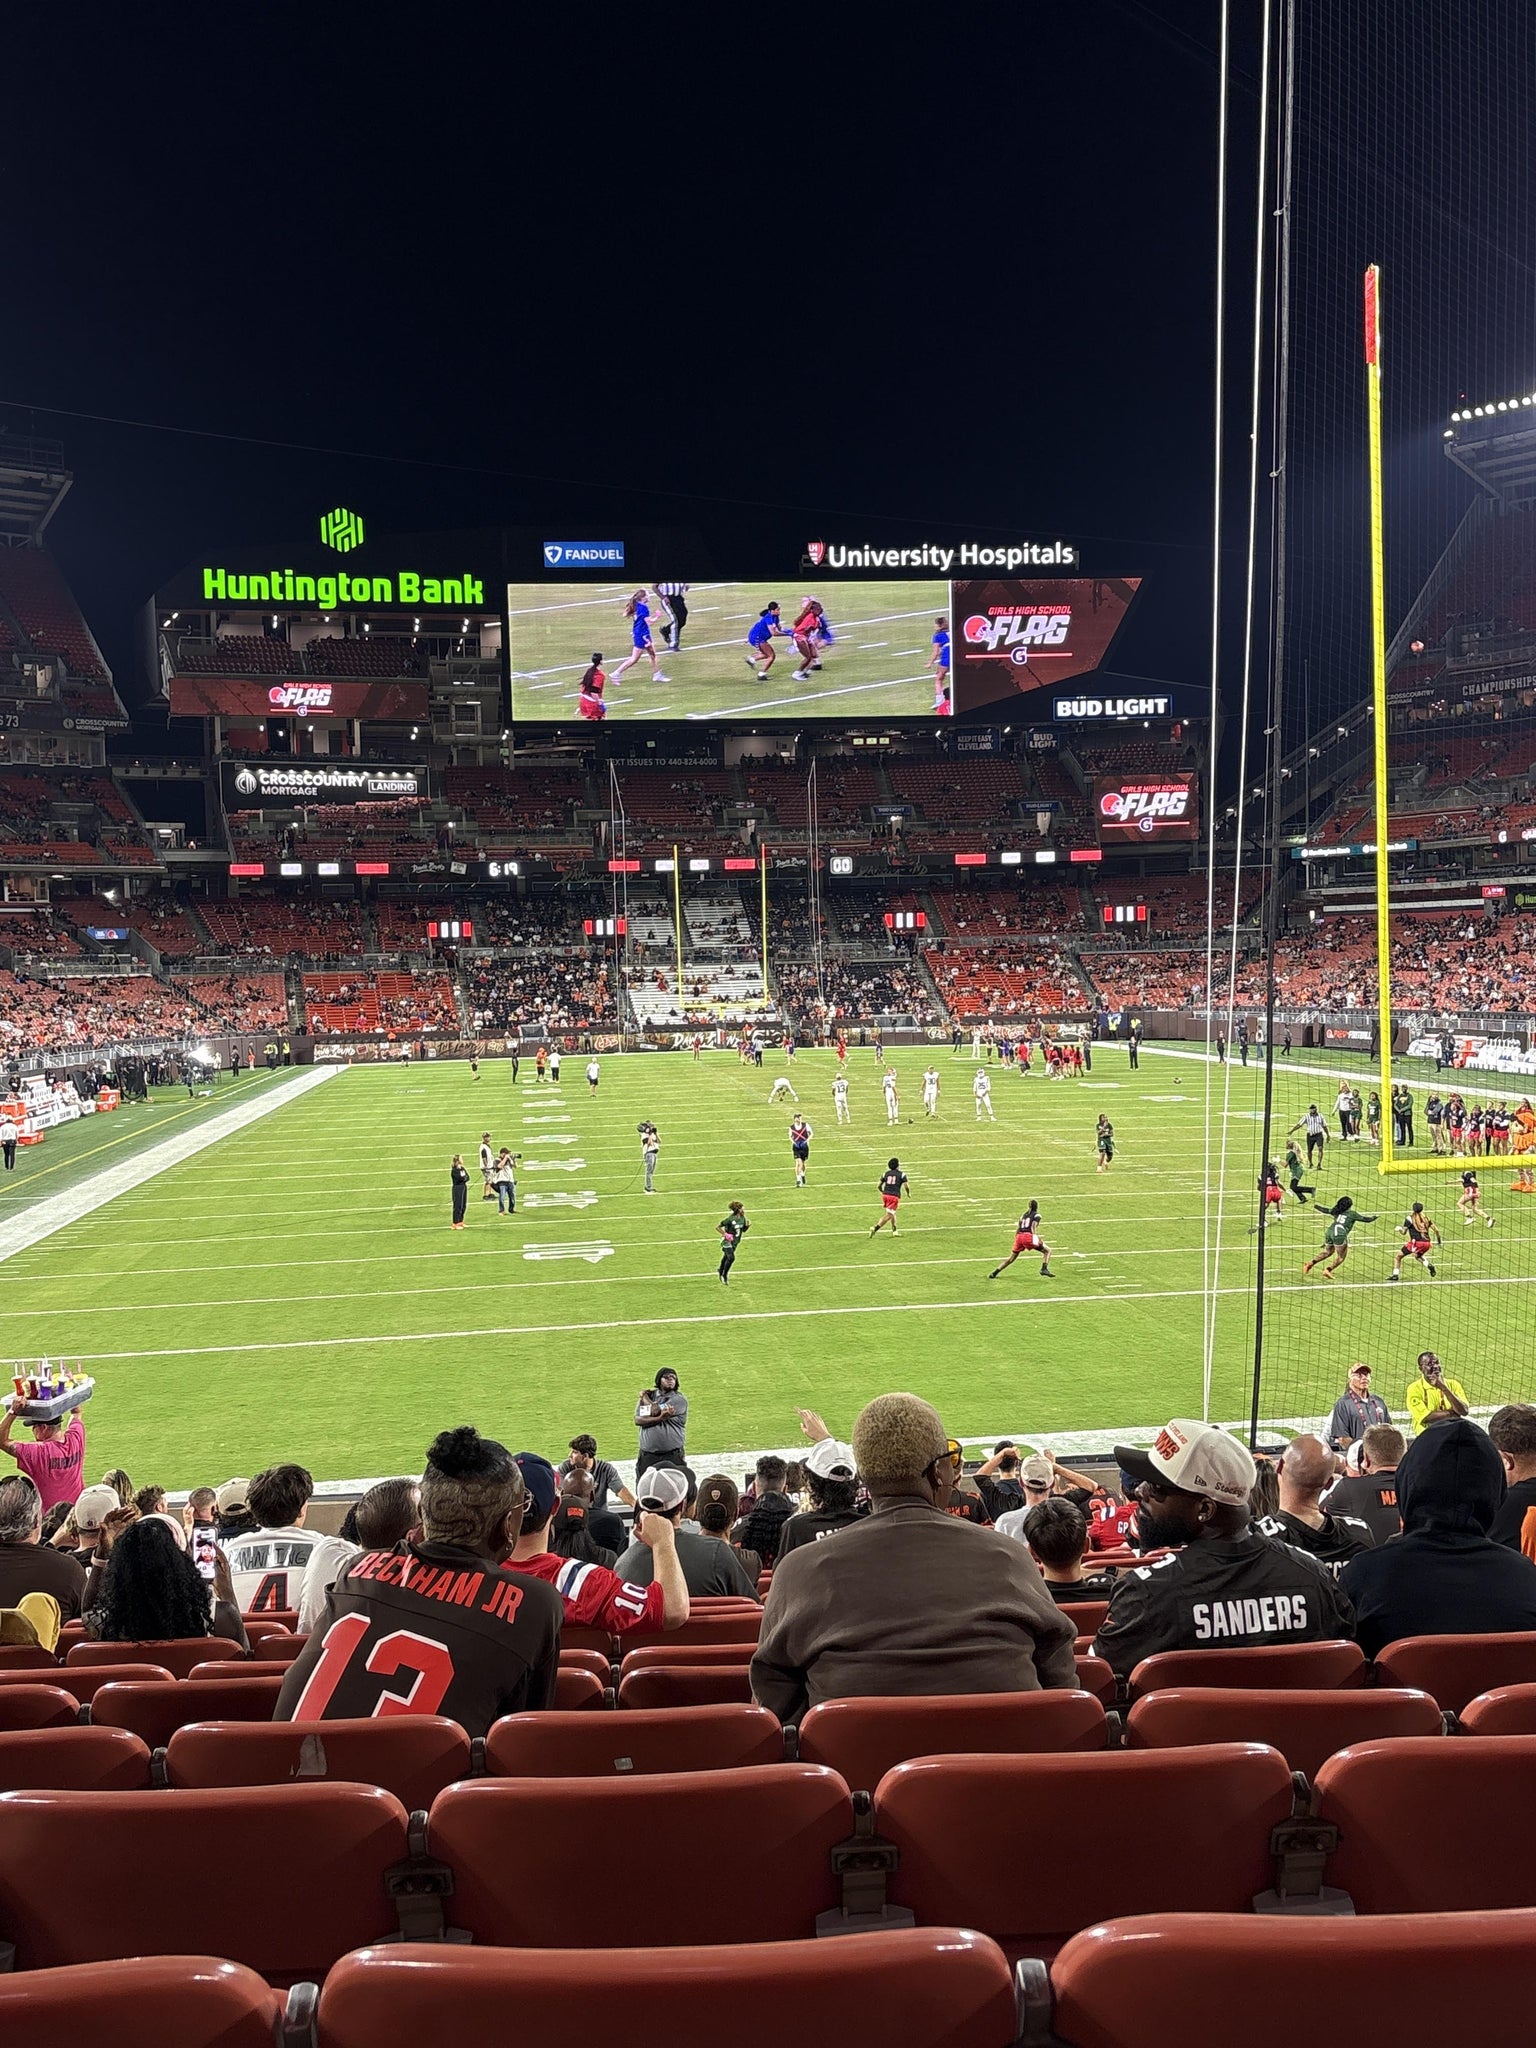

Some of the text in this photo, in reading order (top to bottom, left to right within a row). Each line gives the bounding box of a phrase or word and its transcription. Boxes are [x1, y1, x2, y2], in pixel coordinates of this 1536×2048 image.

[565, 549, 624, 561] FANDUEL
[828, 541, 1074, 571] University Hospitals
[203, 567, 484, 610] Huntington Bank
[988, 605, 1072, 615] GIRLS HIGH SCHOOL
[987, 615, 1071, 650] FLAG
[283, 688, 332, 707] FLAG
[1056, 698, 1168, 717] BUD LIGHT
[75, 718, 129, 728] CROSSCOUNTRY
[1029, 740, 1057, 749] LIGHT
[1032, 733, 1053, 741] BUD
[627, 758, 653, 766] ISSUES
[655, 758, 666, 766] TO
[259, 773, 366, 788] CROSSCOUNTRY
[370, 781, 416, 792] LANDING
[261, 785, 318, 796] MORTGAGE
[1119, 792, 1189, 820] FLAG
[346, 1550, 525, 1625] BECKHAM JR
[613, 1580, 649, 1617] 10
[1193, 1594, 1309, 1640] SANDERS
[290, 1611, 455, 1722] 13
